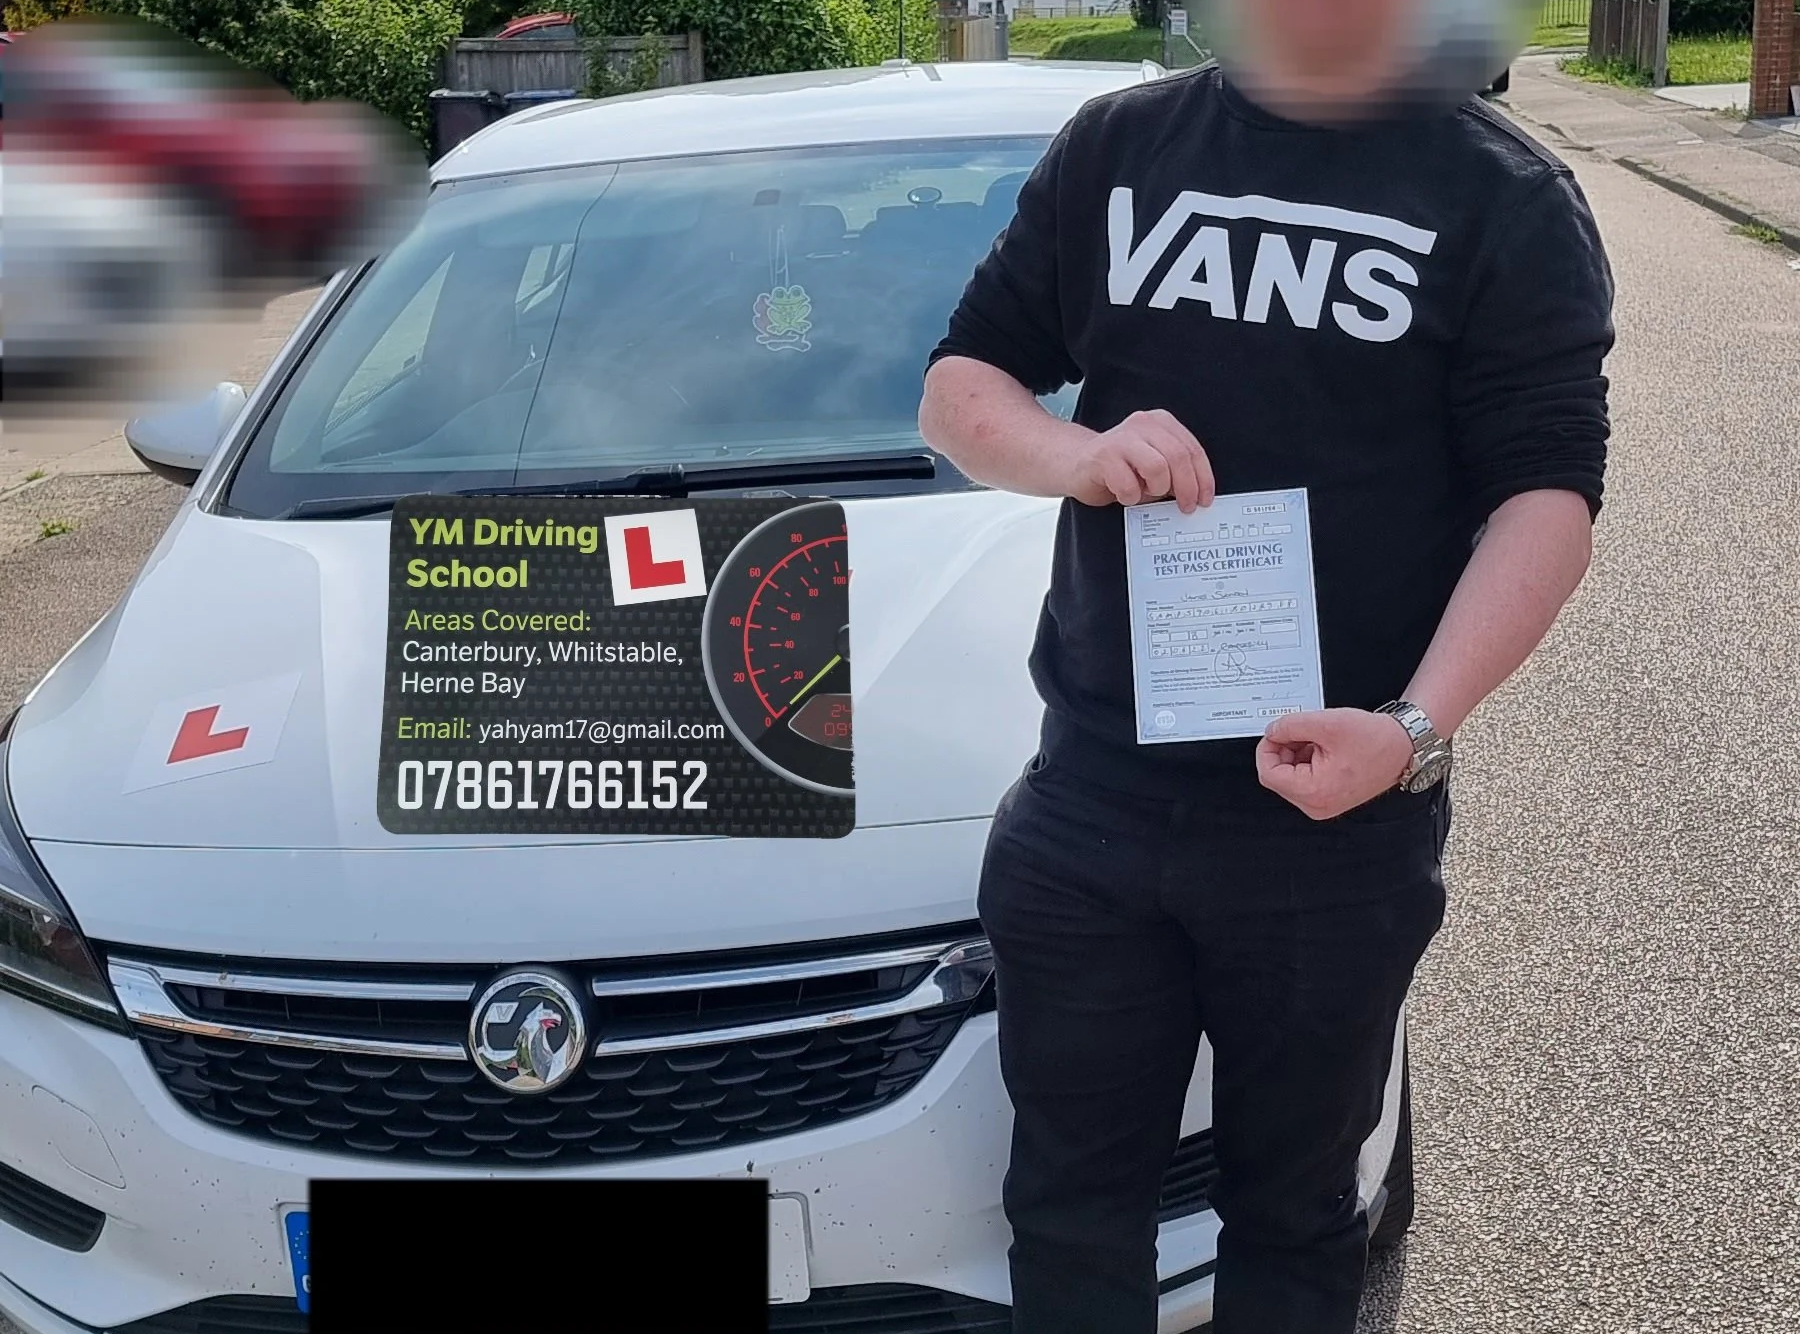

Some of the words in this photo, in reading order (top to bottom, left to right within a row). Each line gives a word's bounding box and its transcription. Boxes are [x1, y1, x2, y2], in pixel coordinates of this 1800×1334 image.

[1107, 186, 1438, 343] VANS
[1153, 549, 1221, 565] PRACTICAL
[1225, 543, 1283, 558] DRIVING
[1154, 565, 1180, 576] TEST
[1183, 562, 1210, 573] PASS
[1212, 556, 1283, 571] CERTIFICATE
[166, 705, 250, 764] L
